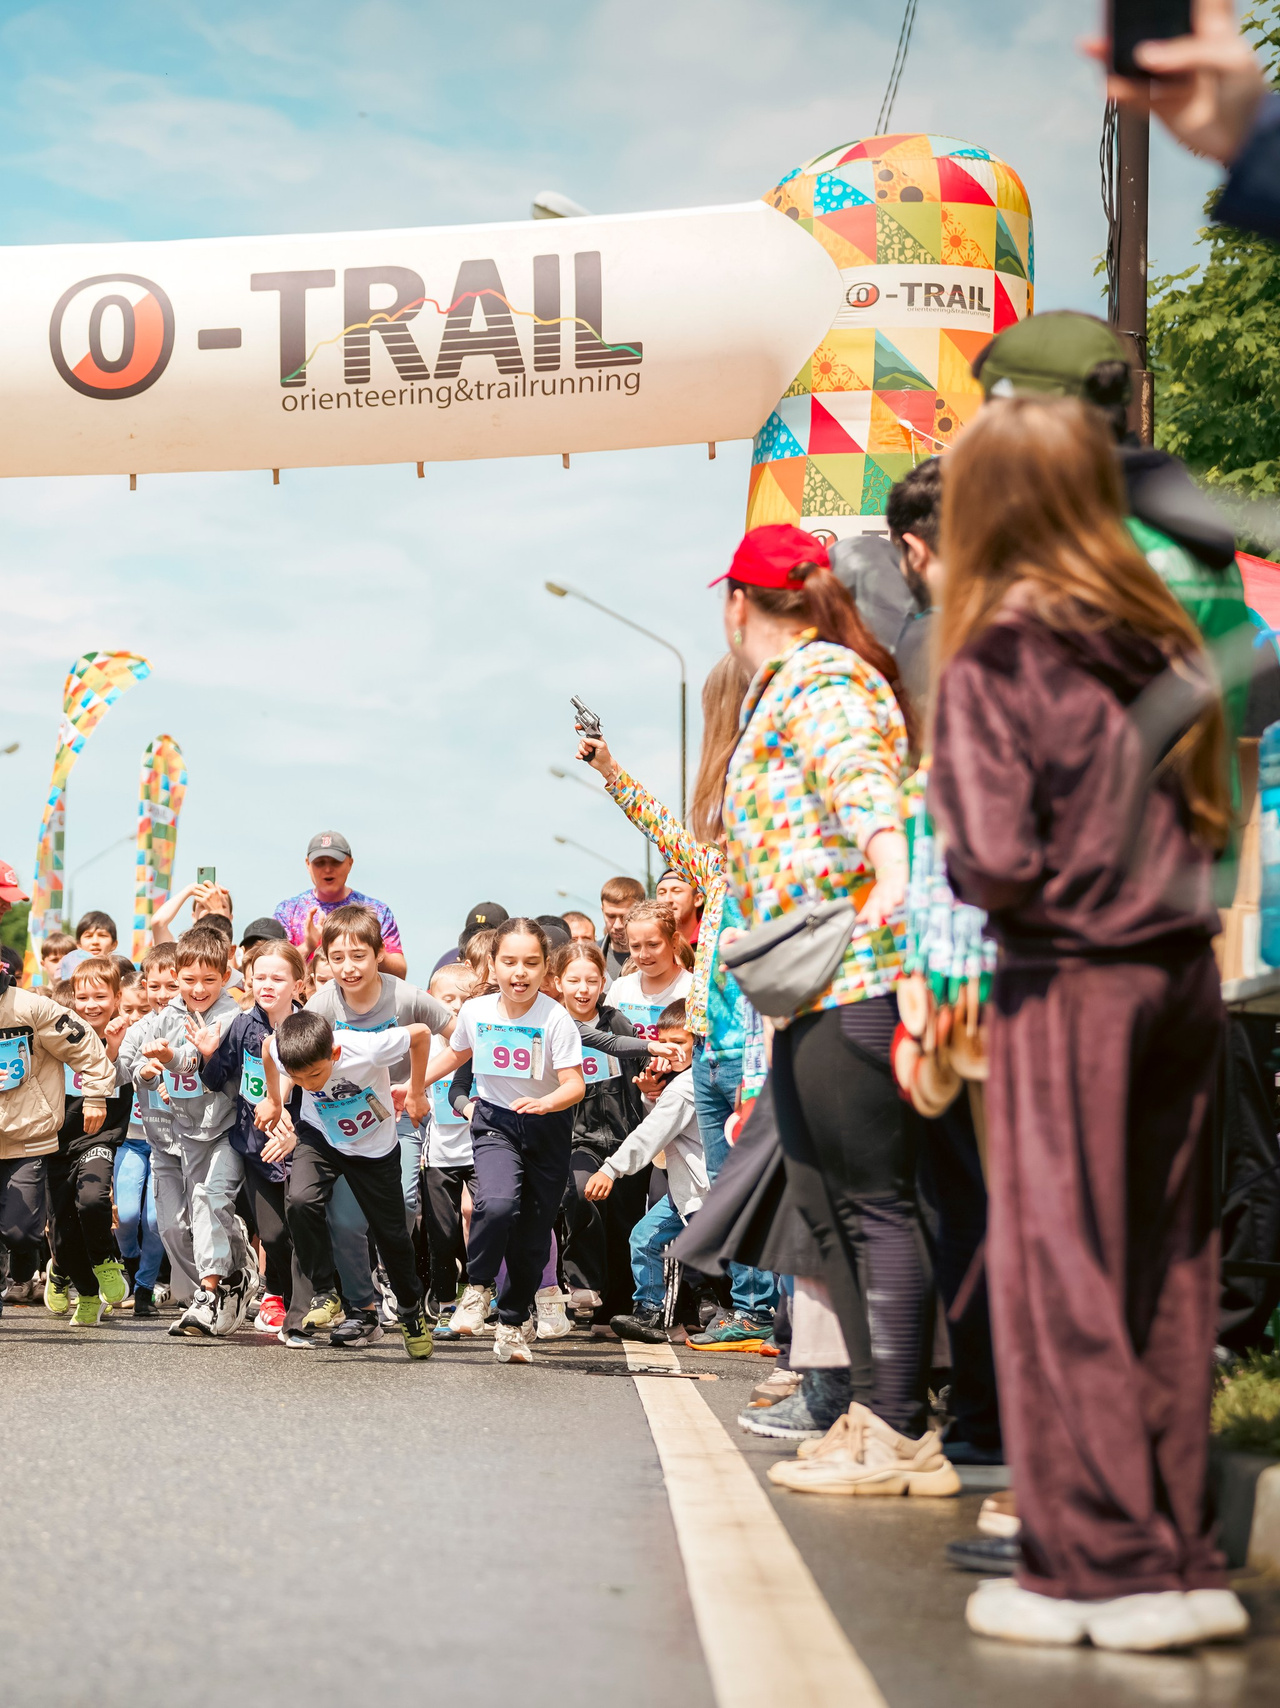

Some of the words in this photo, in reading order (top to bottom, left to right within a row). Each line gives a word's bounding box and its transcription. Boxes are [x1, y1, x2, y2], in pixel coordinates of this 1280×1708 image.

[907, 307, 991, 318] orienteering&trailrunning
[281, 369, 642, 411] orienteering&trailrunning
[55, 1014, 85, 1044] 3
[493, 1046, 531, 1070] 99
[245, 1072, 267, 1097] 13
[337, 1110, 377, 1137] 92
